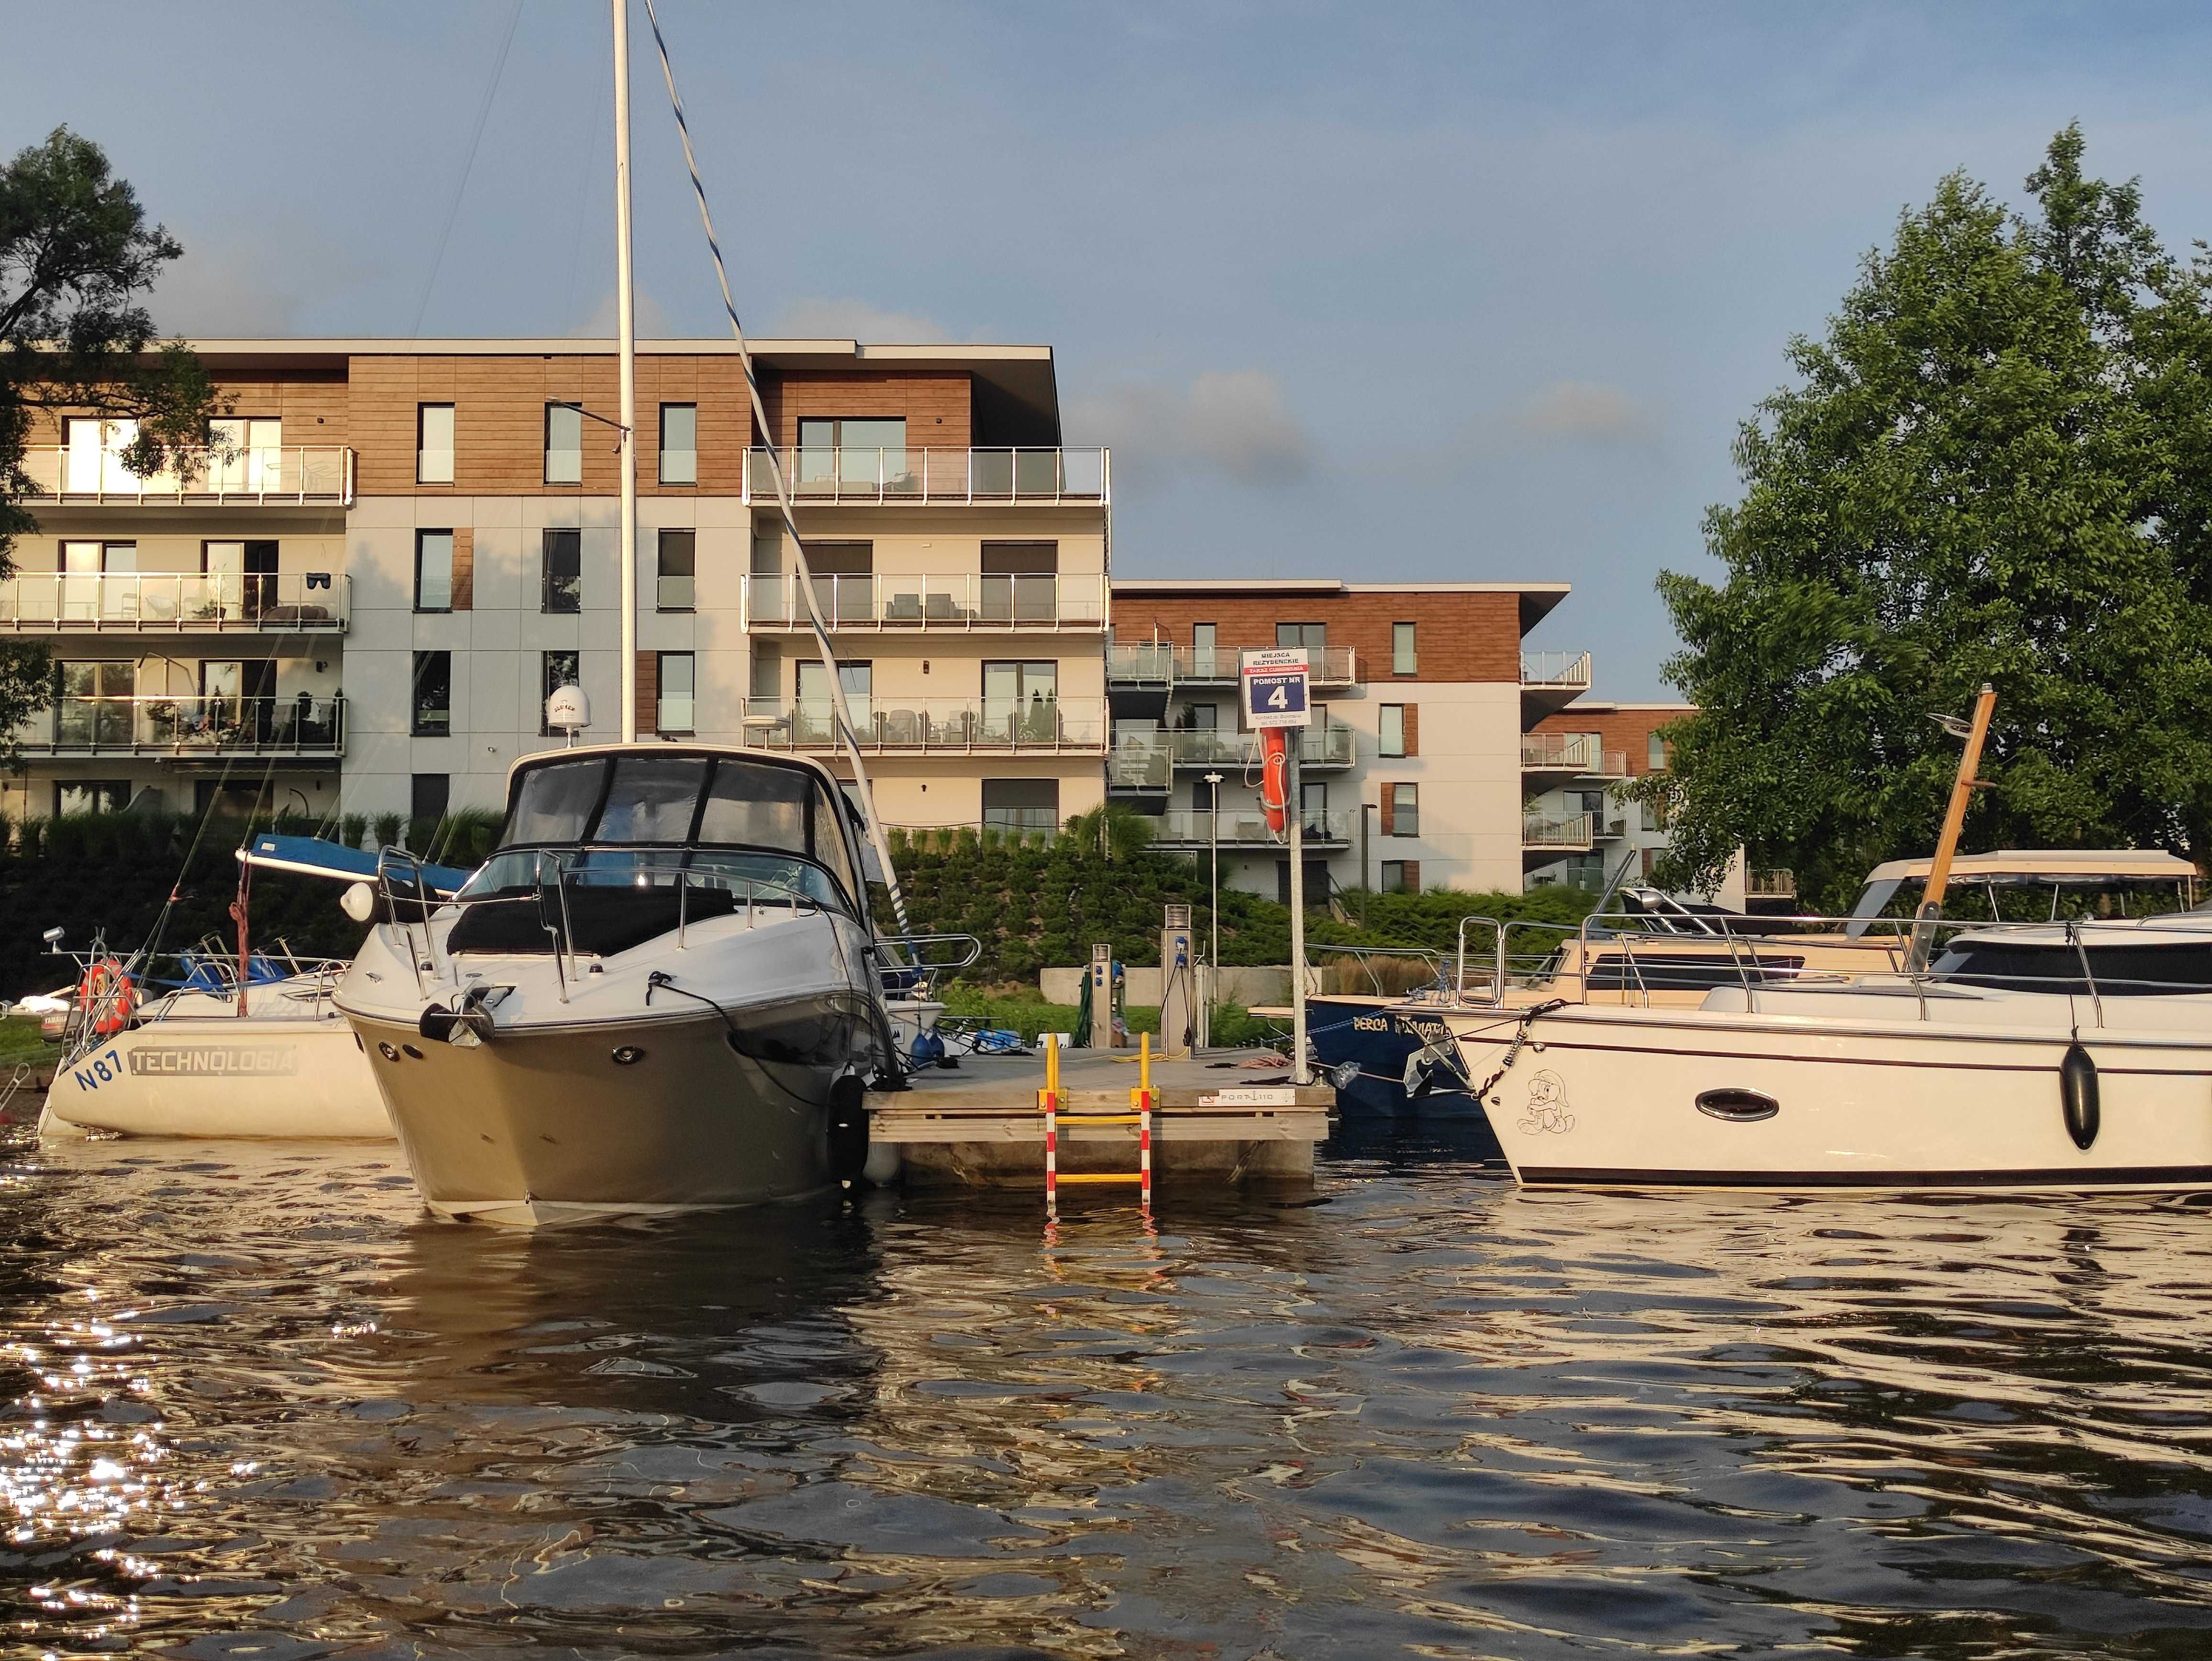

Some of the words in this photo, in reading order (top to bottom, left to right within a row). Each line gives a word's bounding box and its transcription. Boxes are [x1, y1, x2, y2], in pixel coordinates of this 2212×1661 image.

[1268, 685, 1288, 709] 4
[1353, 1017, 1388, 1031] PERCA
[75, 1050, 122, 1091] N87
[132, 1051, 297, 1071] TECHNOLOGIA
